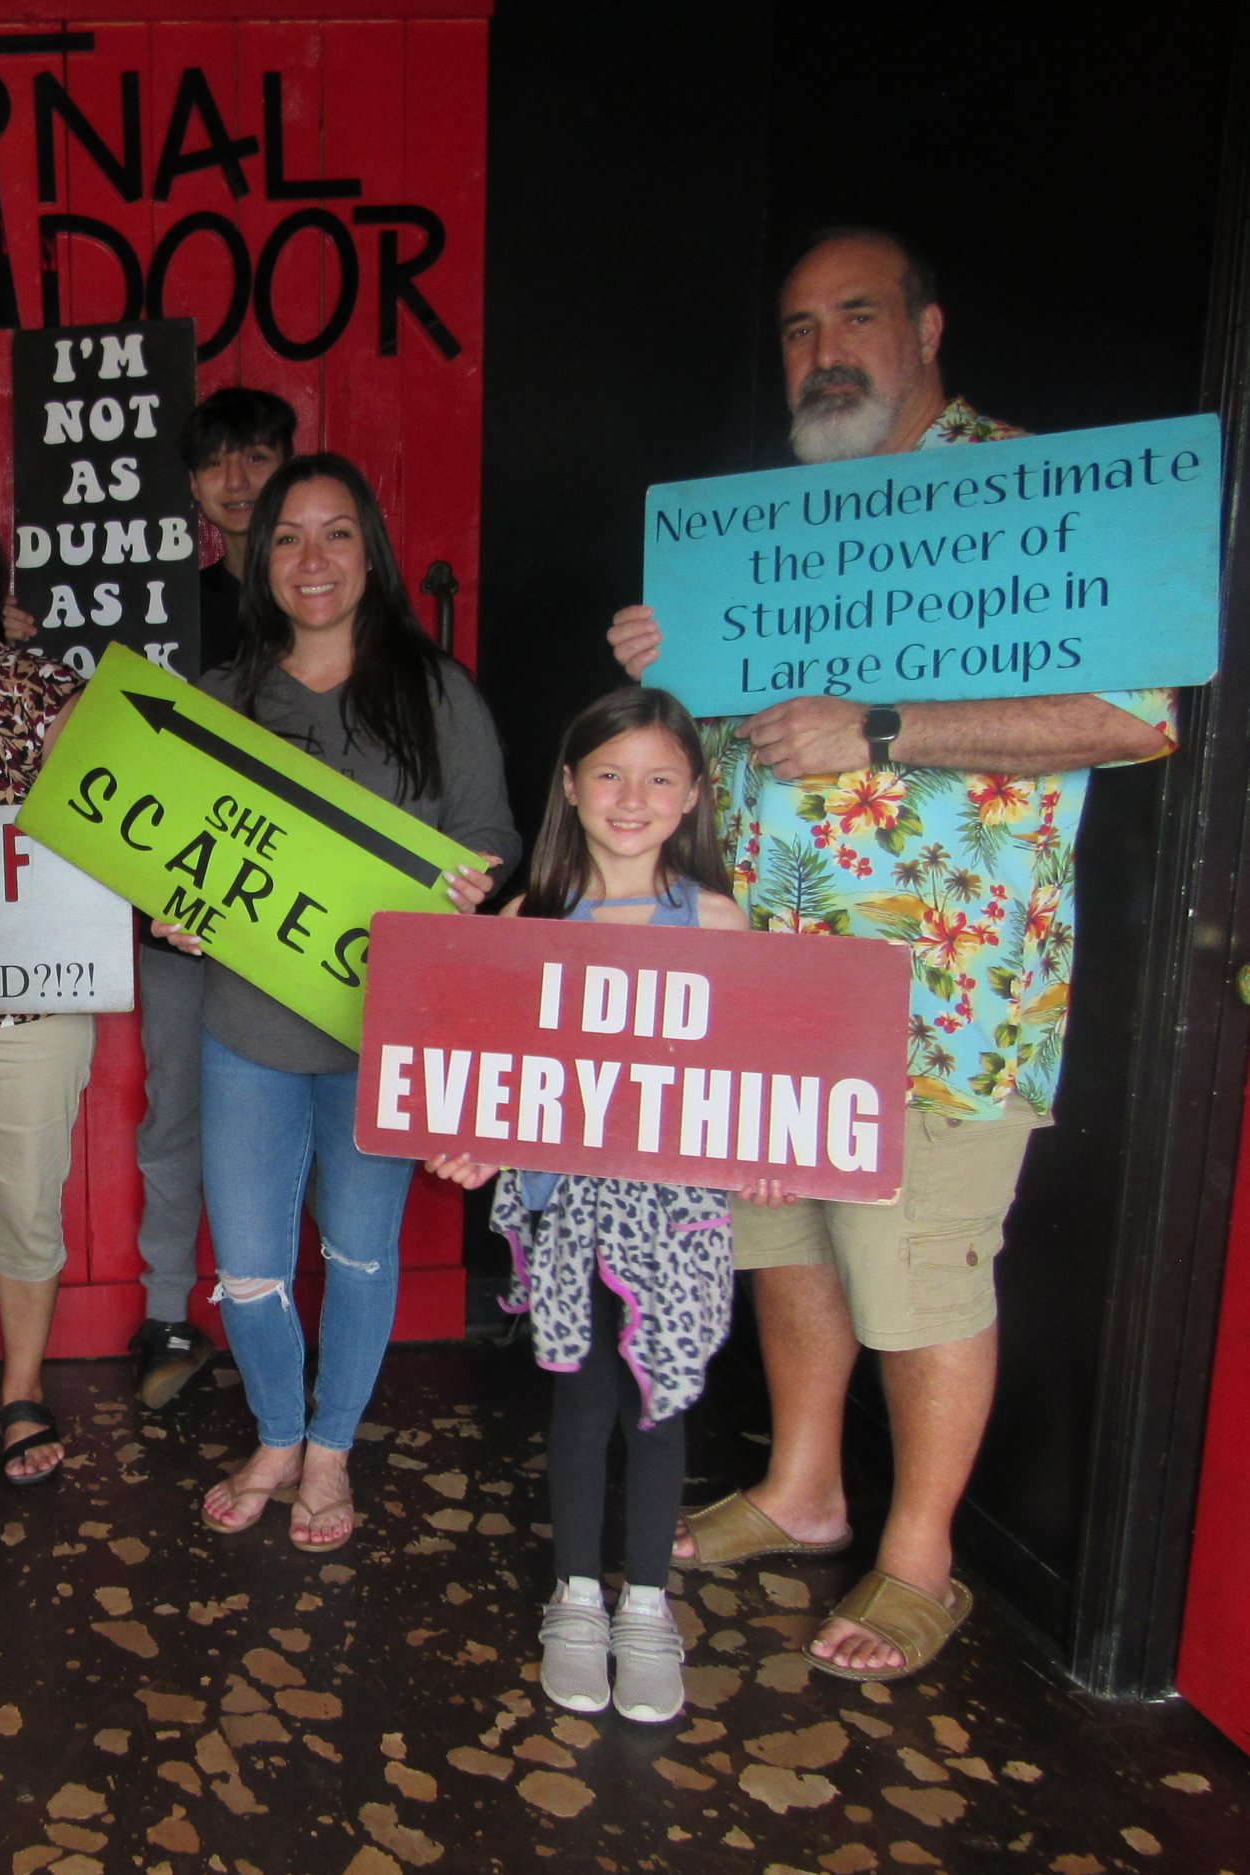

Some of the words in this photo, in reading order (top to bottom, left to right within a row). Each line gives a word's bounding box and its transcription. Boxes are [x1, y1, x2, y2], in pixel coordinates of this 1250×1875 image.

[39, 204, 462, 363] DOOR
[53, 334, 148, 383] I'M
[43, 395, 160, 444] NOT
[62, 458, 141, 504] AS
[655, 499, 789, 544] Never
[803, 446, 1200, 526] Underestimate
[15, 517, 194, 569] DUMB
[749, 546, 825, 585] the
[838, 526, 1005, 576] Power
[1020, 511, 1080, 556] of
[42, 583, 123, 628] AS
[145, 581, 168, 624] I
[722, 590, 874, 643] Stupid
[886, 575, 1050, 628] People
[1064, 571, 1108, 609] in
[741, 653, 882, 696] Large
[895, 634, 1082, 682] Groups
[205, 795, 287, 860] SHE
[67, 766, 371, 988] SCARES
[162, 885, 227, 945] ME
[538, 962, 563, 1030] I
[581, 965, 710, 1041] DID
[376, 1044, 880, 1173] EVERYTHING
